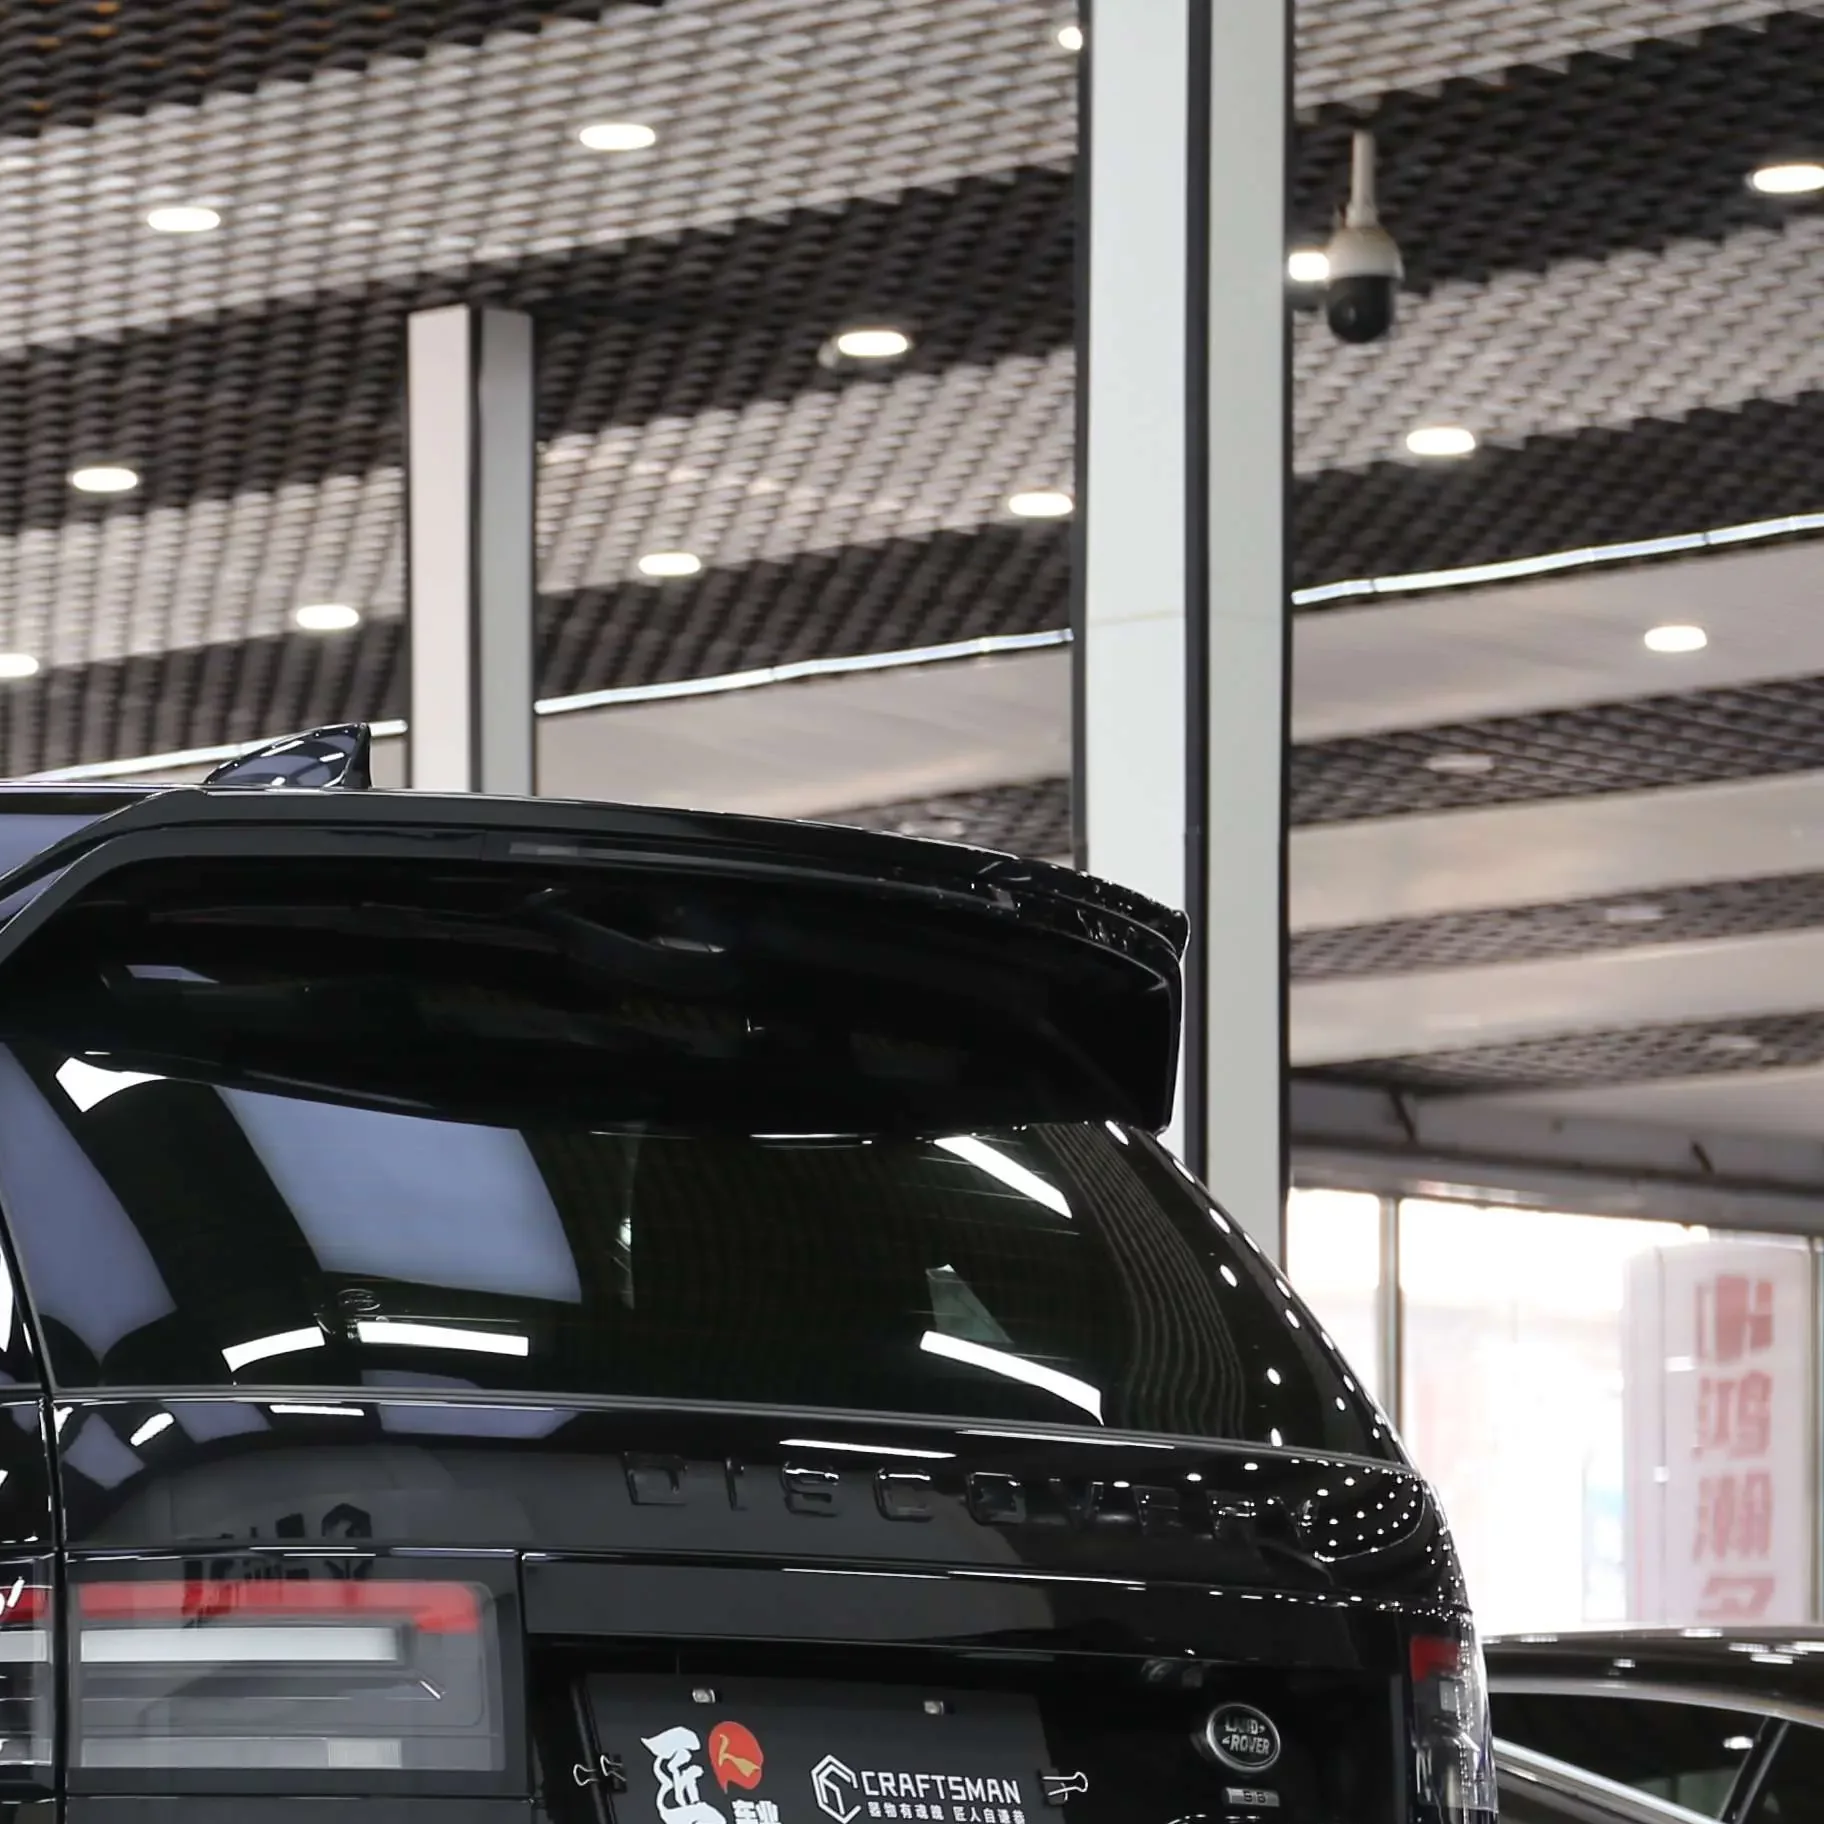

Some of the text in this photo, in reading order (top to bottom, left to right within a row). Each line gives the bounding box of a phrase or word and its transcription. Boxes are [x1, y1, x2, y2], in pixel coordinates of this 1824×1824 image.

[623, 1451, 1318, 1541] DISCOVERY
[1229, 1733, 1270, 1755] ROVER
[860, 1770, 1022, 1805] CRAFTSMAN
